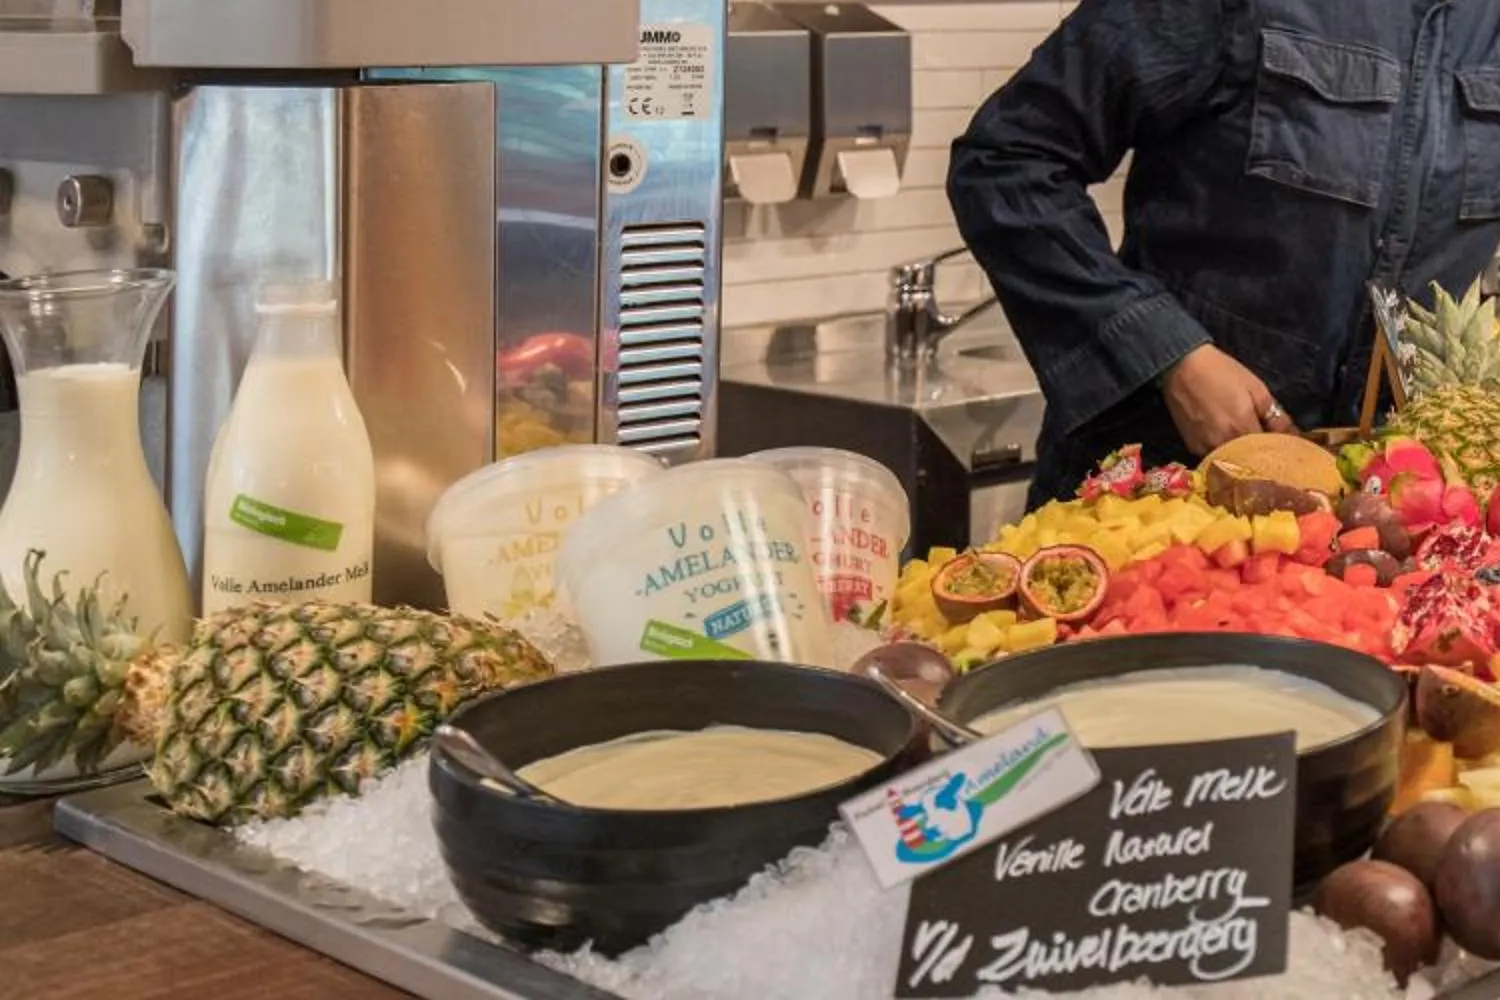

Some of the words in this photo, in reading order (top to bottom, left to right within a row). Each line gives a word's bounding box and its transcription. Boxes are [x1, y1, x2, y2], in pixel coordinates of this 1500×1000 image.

[640, 31, 681, 43] UMMO
[525, 494, 586, 527] Vol
[812, 495, 871, 522] olle
[247, 571, 341, 595] Amelander
[643, 541, 796, 597] AMELADER
[994, 835, 1086, 882] Vanille
[1088, 867, 1271, 926] Cranberry
